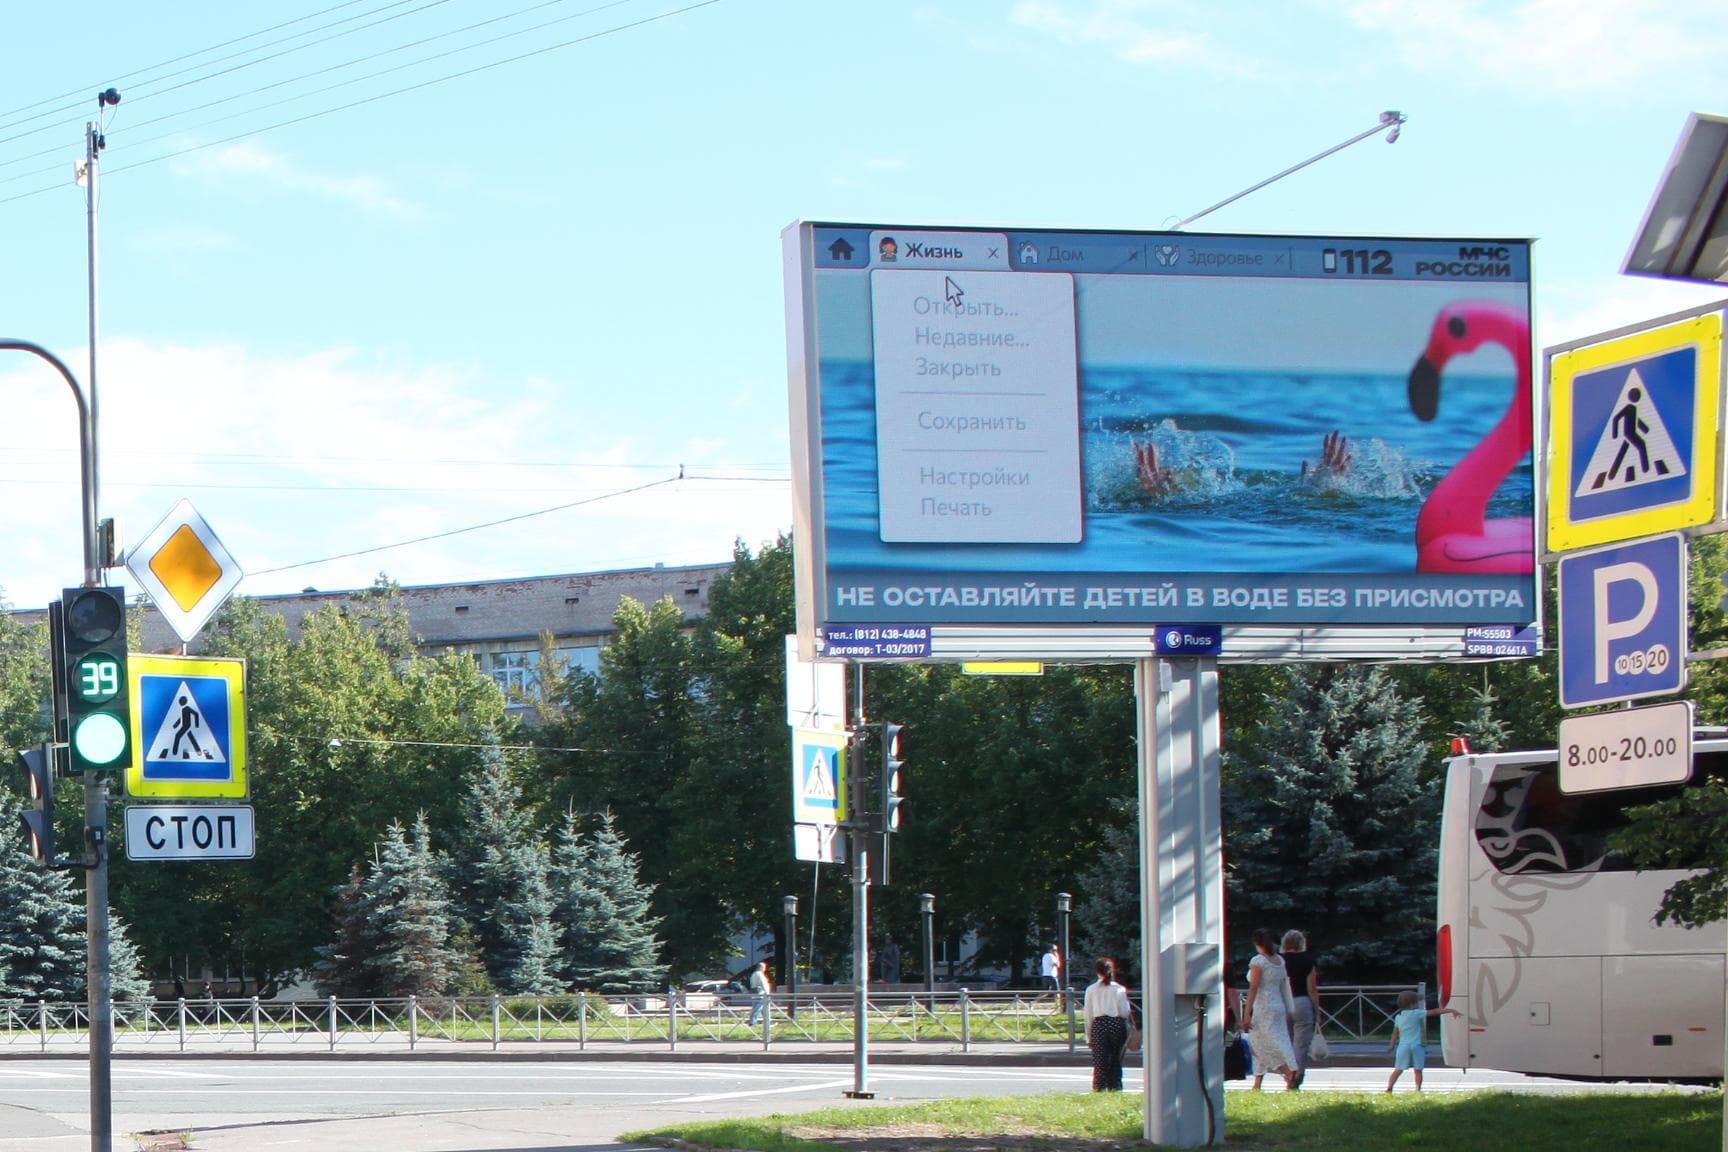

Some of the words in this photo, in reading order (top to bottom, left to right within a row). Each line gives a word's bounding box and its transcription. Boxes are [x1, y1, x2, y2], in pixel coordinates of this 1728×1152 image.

[904, 241, 964, 260] Жизнь
[1046, 246, 1084, 264] Дом
[1186, 244, 1265, 267] Здоровье
[1458, 246, 1511, 262] МЧС
[1339, 249, 1394, 275] 112
[1415, 262, 1512, 278] РОССИИ
[915, 357, 1002, 381] Закрыть
[917, 410, 1027, 434] Сохранить
[919, 466, 1032, 490] Настройки
[920, 497, 993, 518] Печать
[836, 587, 875, 607] НЕ
[882, 582, 1076, 607] ОСТАВЛЯЙТЕ
[1083, 582, 1179, 610] ДЕТЕЙ
[1186, 588, 1204, 607] В
[1212, 588, 1288, 610] ВОДЕ
[1296, 588, 1347, 608] БЕЗ
[1354, 588, 1525, 608] ПРИСМОТРА
[854, 628, 879, 640] (812)
[1183, 634, 1212, 646] Russ
[829, 646, 874, 656] договор:
[1617, 657, 1628, 671] 10
[1631, 653, 1644, 670] 15
[1647, 649, 1667, 669] 20
[80, 661, 119, 696] 39
[144, 814, 237, 851] СТОП
